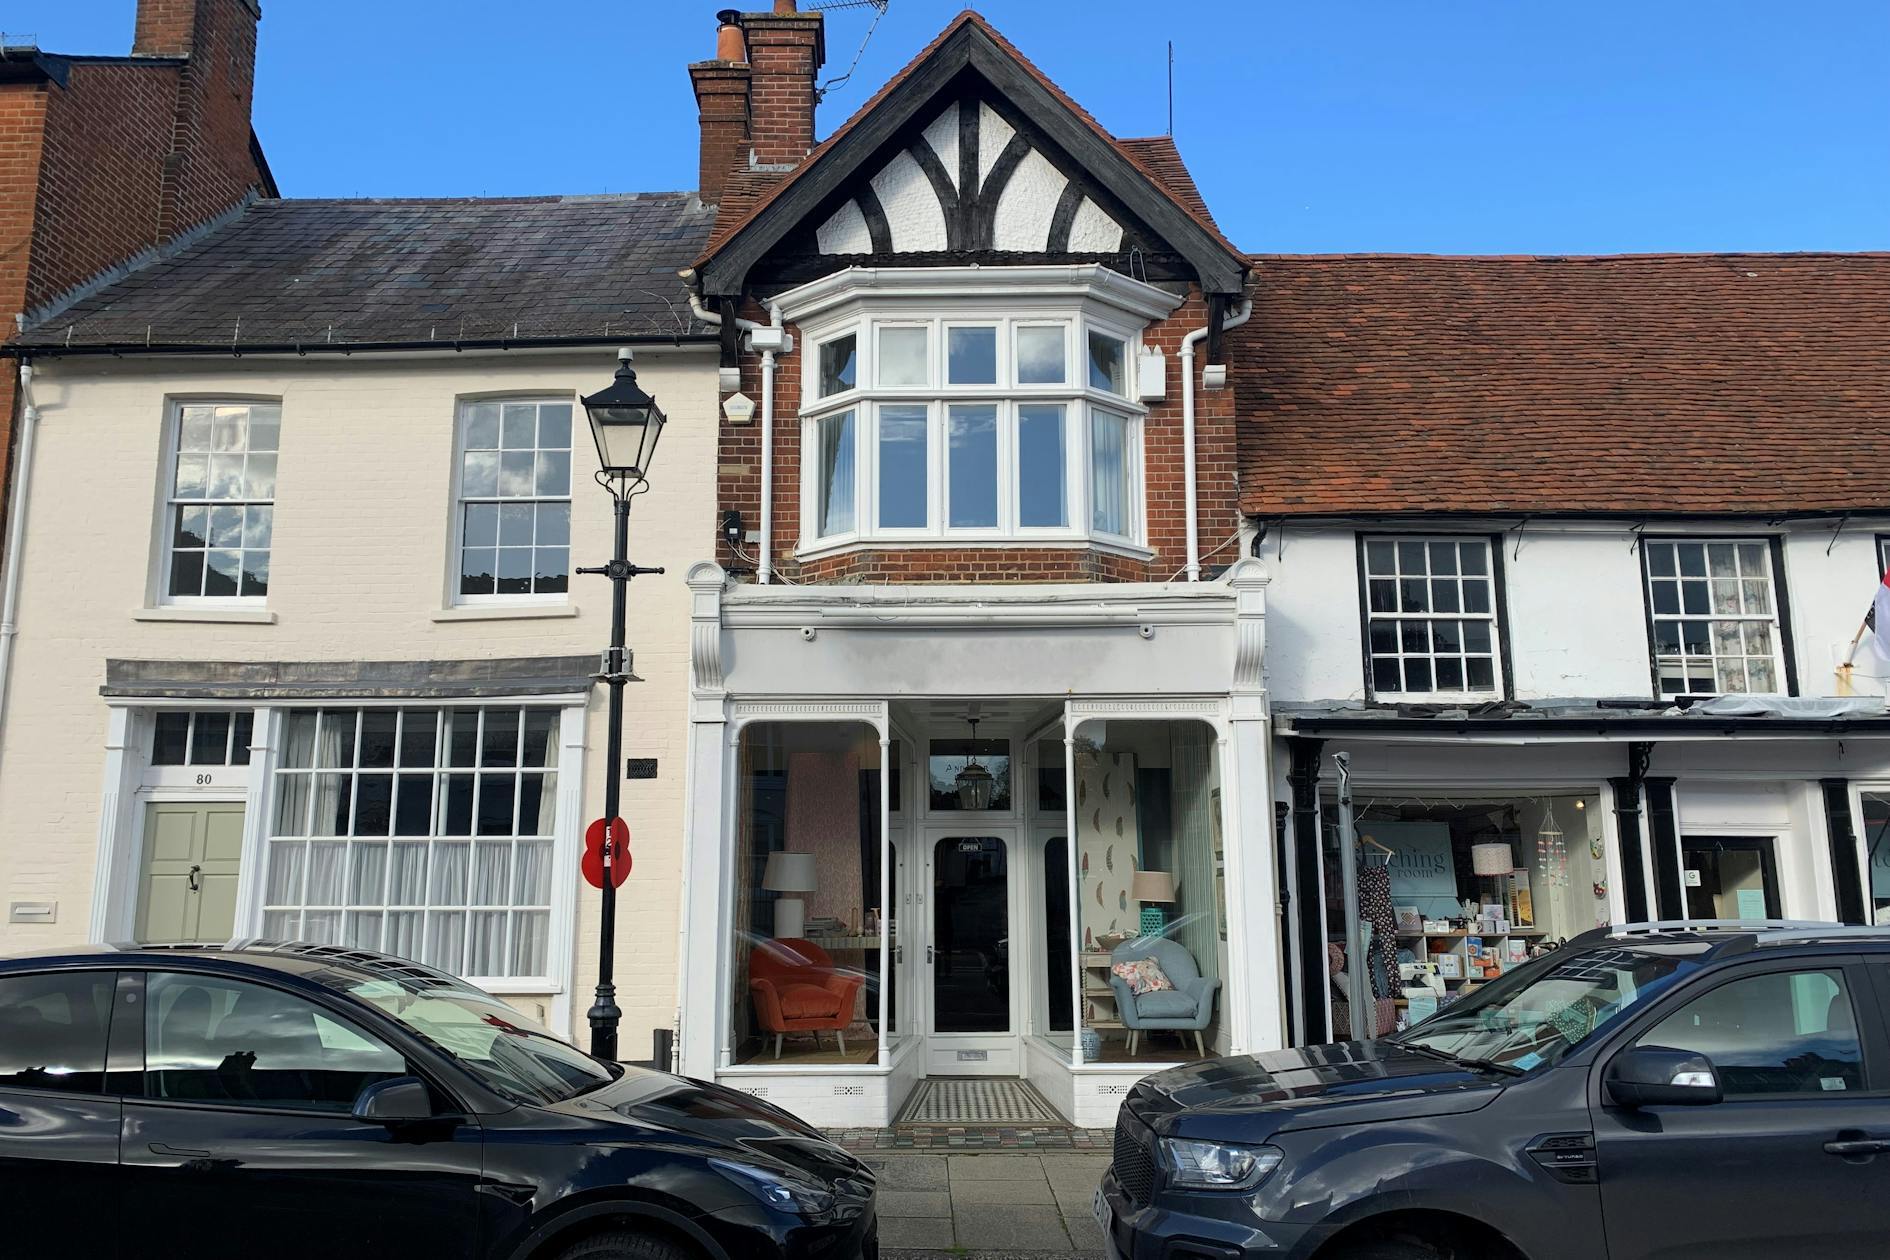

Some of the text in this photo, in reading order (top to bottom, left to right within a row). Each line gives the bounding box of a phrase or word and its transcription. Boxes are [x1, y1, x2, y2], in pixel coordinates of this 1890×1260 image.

[196, 773, 212, 785] 80
[963, 843, 979, 851] OPEN
[1398, 867, 1434, 879] room
